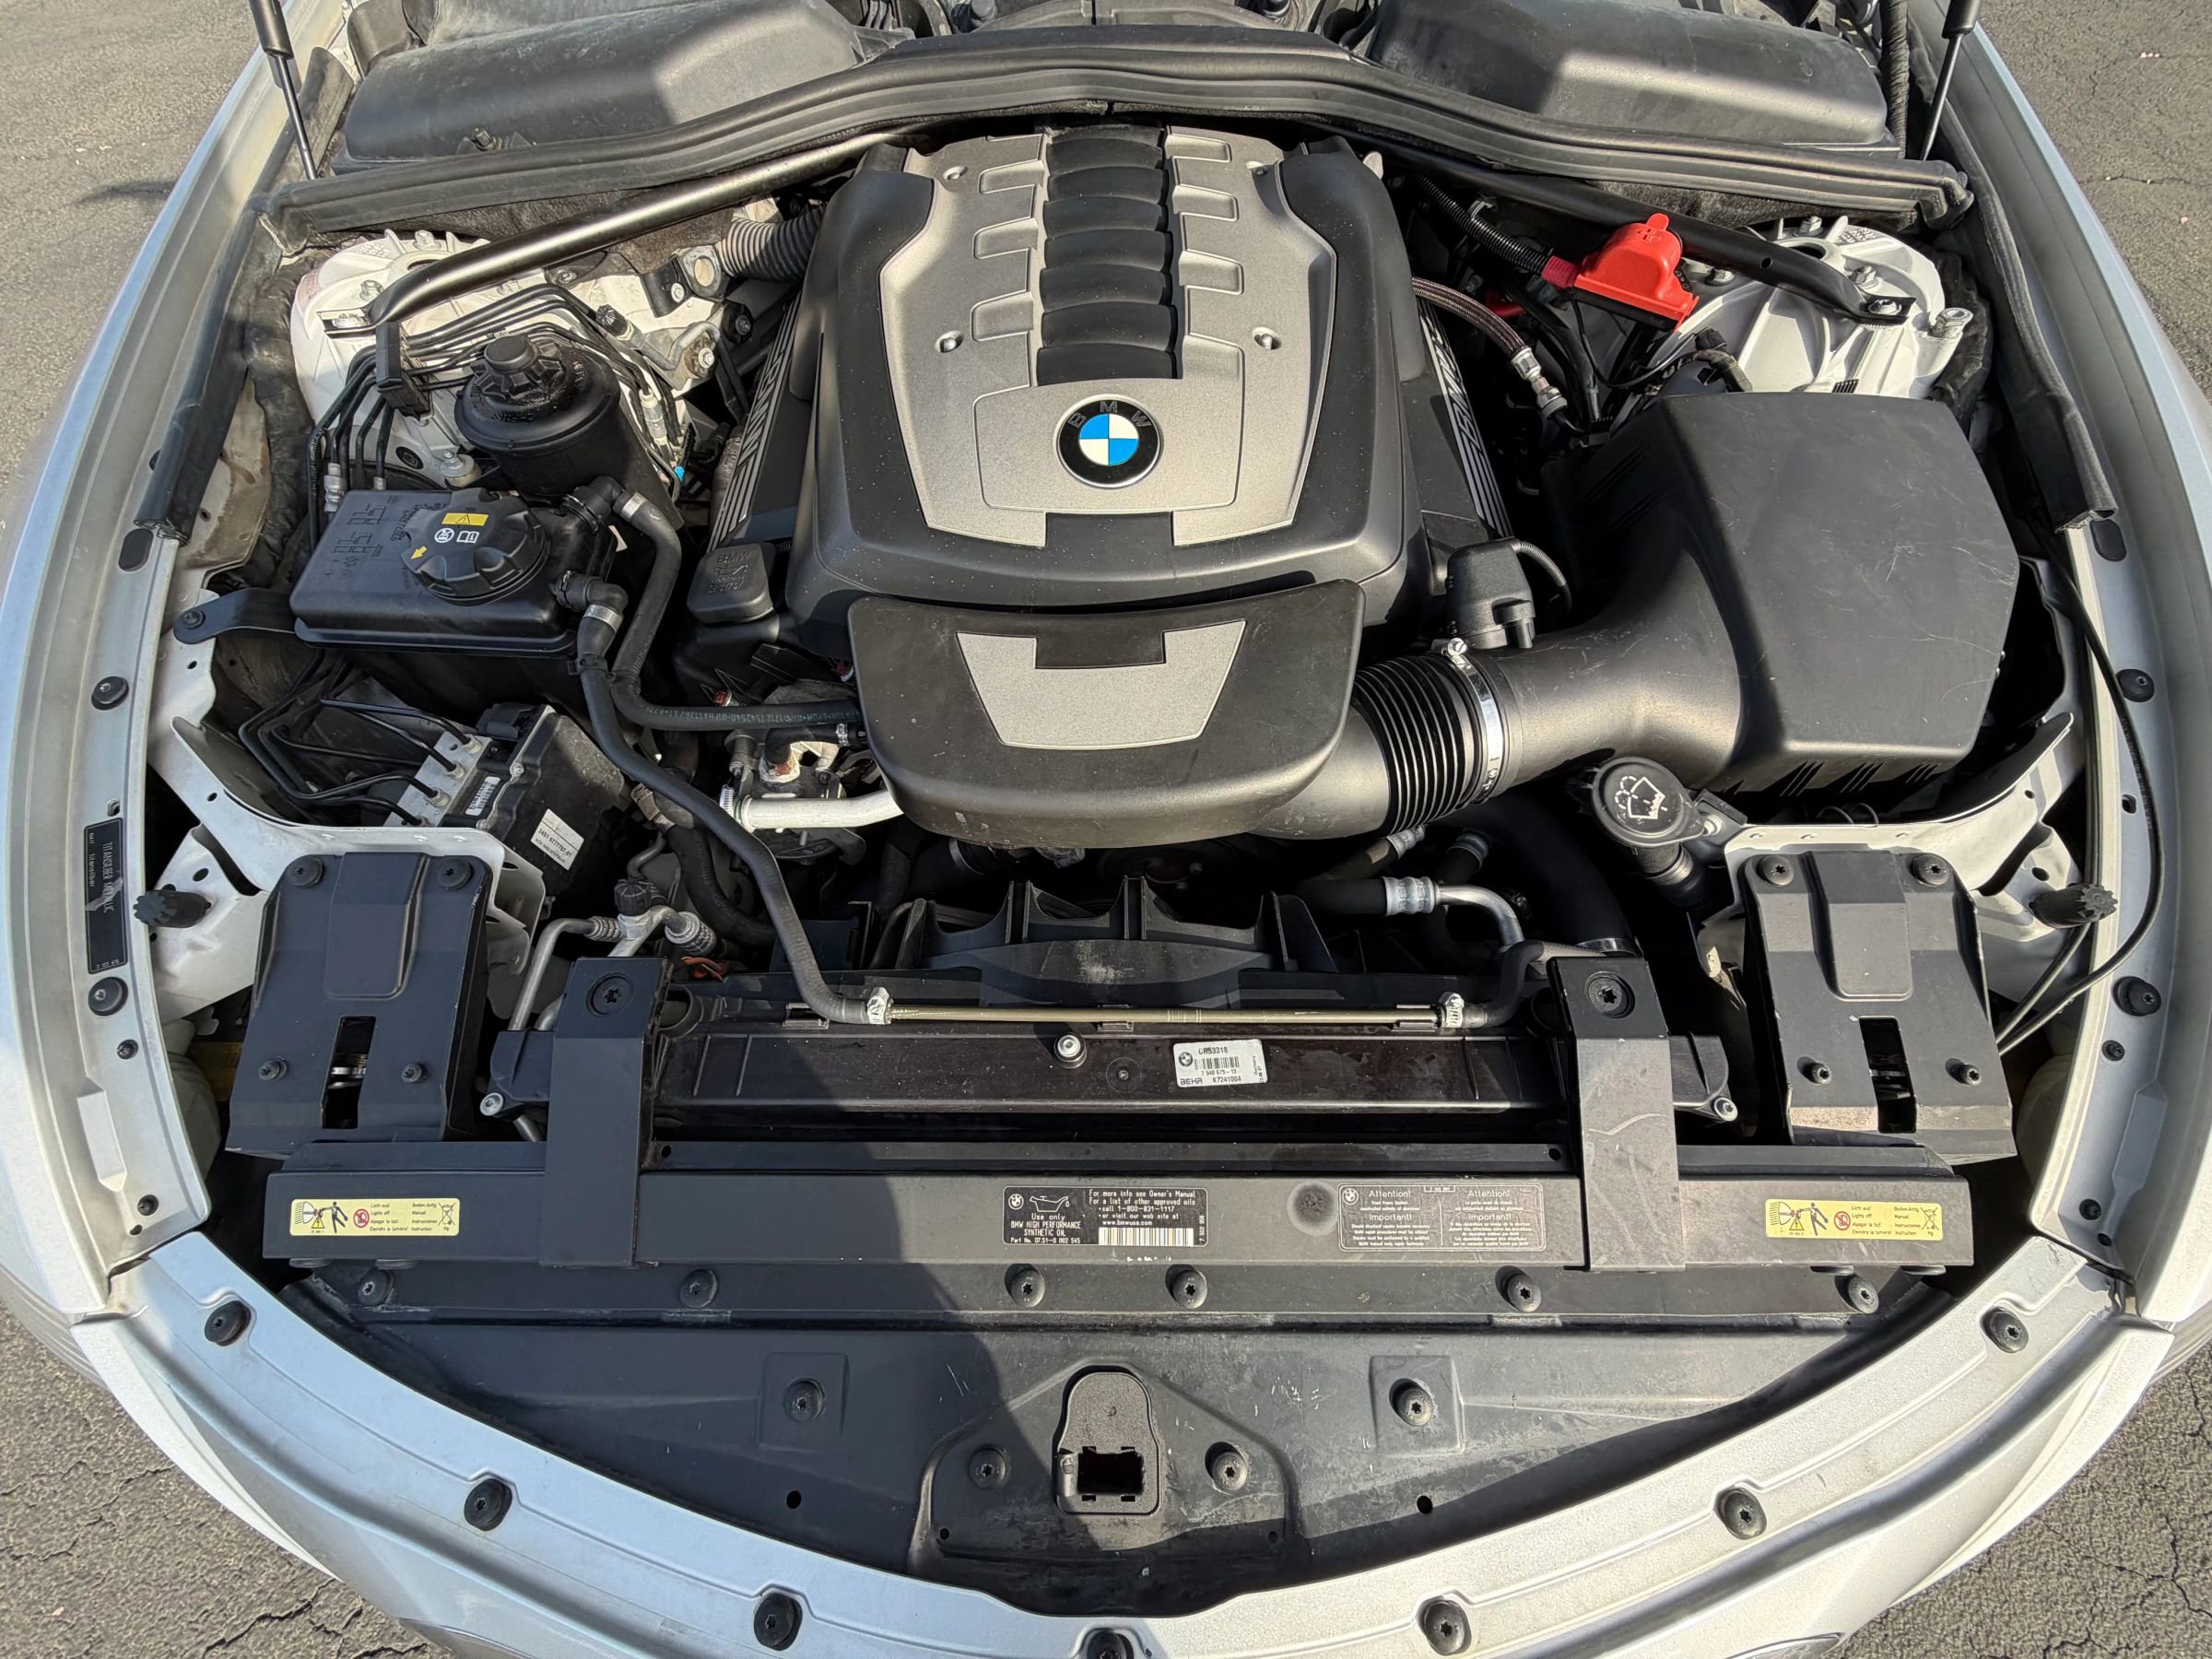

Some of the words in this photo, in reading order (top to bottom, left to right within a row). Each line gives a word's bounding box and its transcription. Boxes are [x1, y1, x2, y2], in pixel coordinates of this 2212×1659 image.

[1067, 401, 1152, 428] BMW
[1088, 1189, 1100, 1197] For
[1175, 1190, 1196, 1198] Manual
[1369, 1190, 1411, 1198] Attention!
[1153, 1198, 1181, 1206] approved
[1049, 1213, 1065, 1221] only
[1369, 1213, 1412, 1221] Important!
[1041, 1221, 1081, 1230] PERFORMANCE
[1023, 1228, 1054, 1236] SYNTHETIC
[1056, 1229, 1066, 1237] OIL
